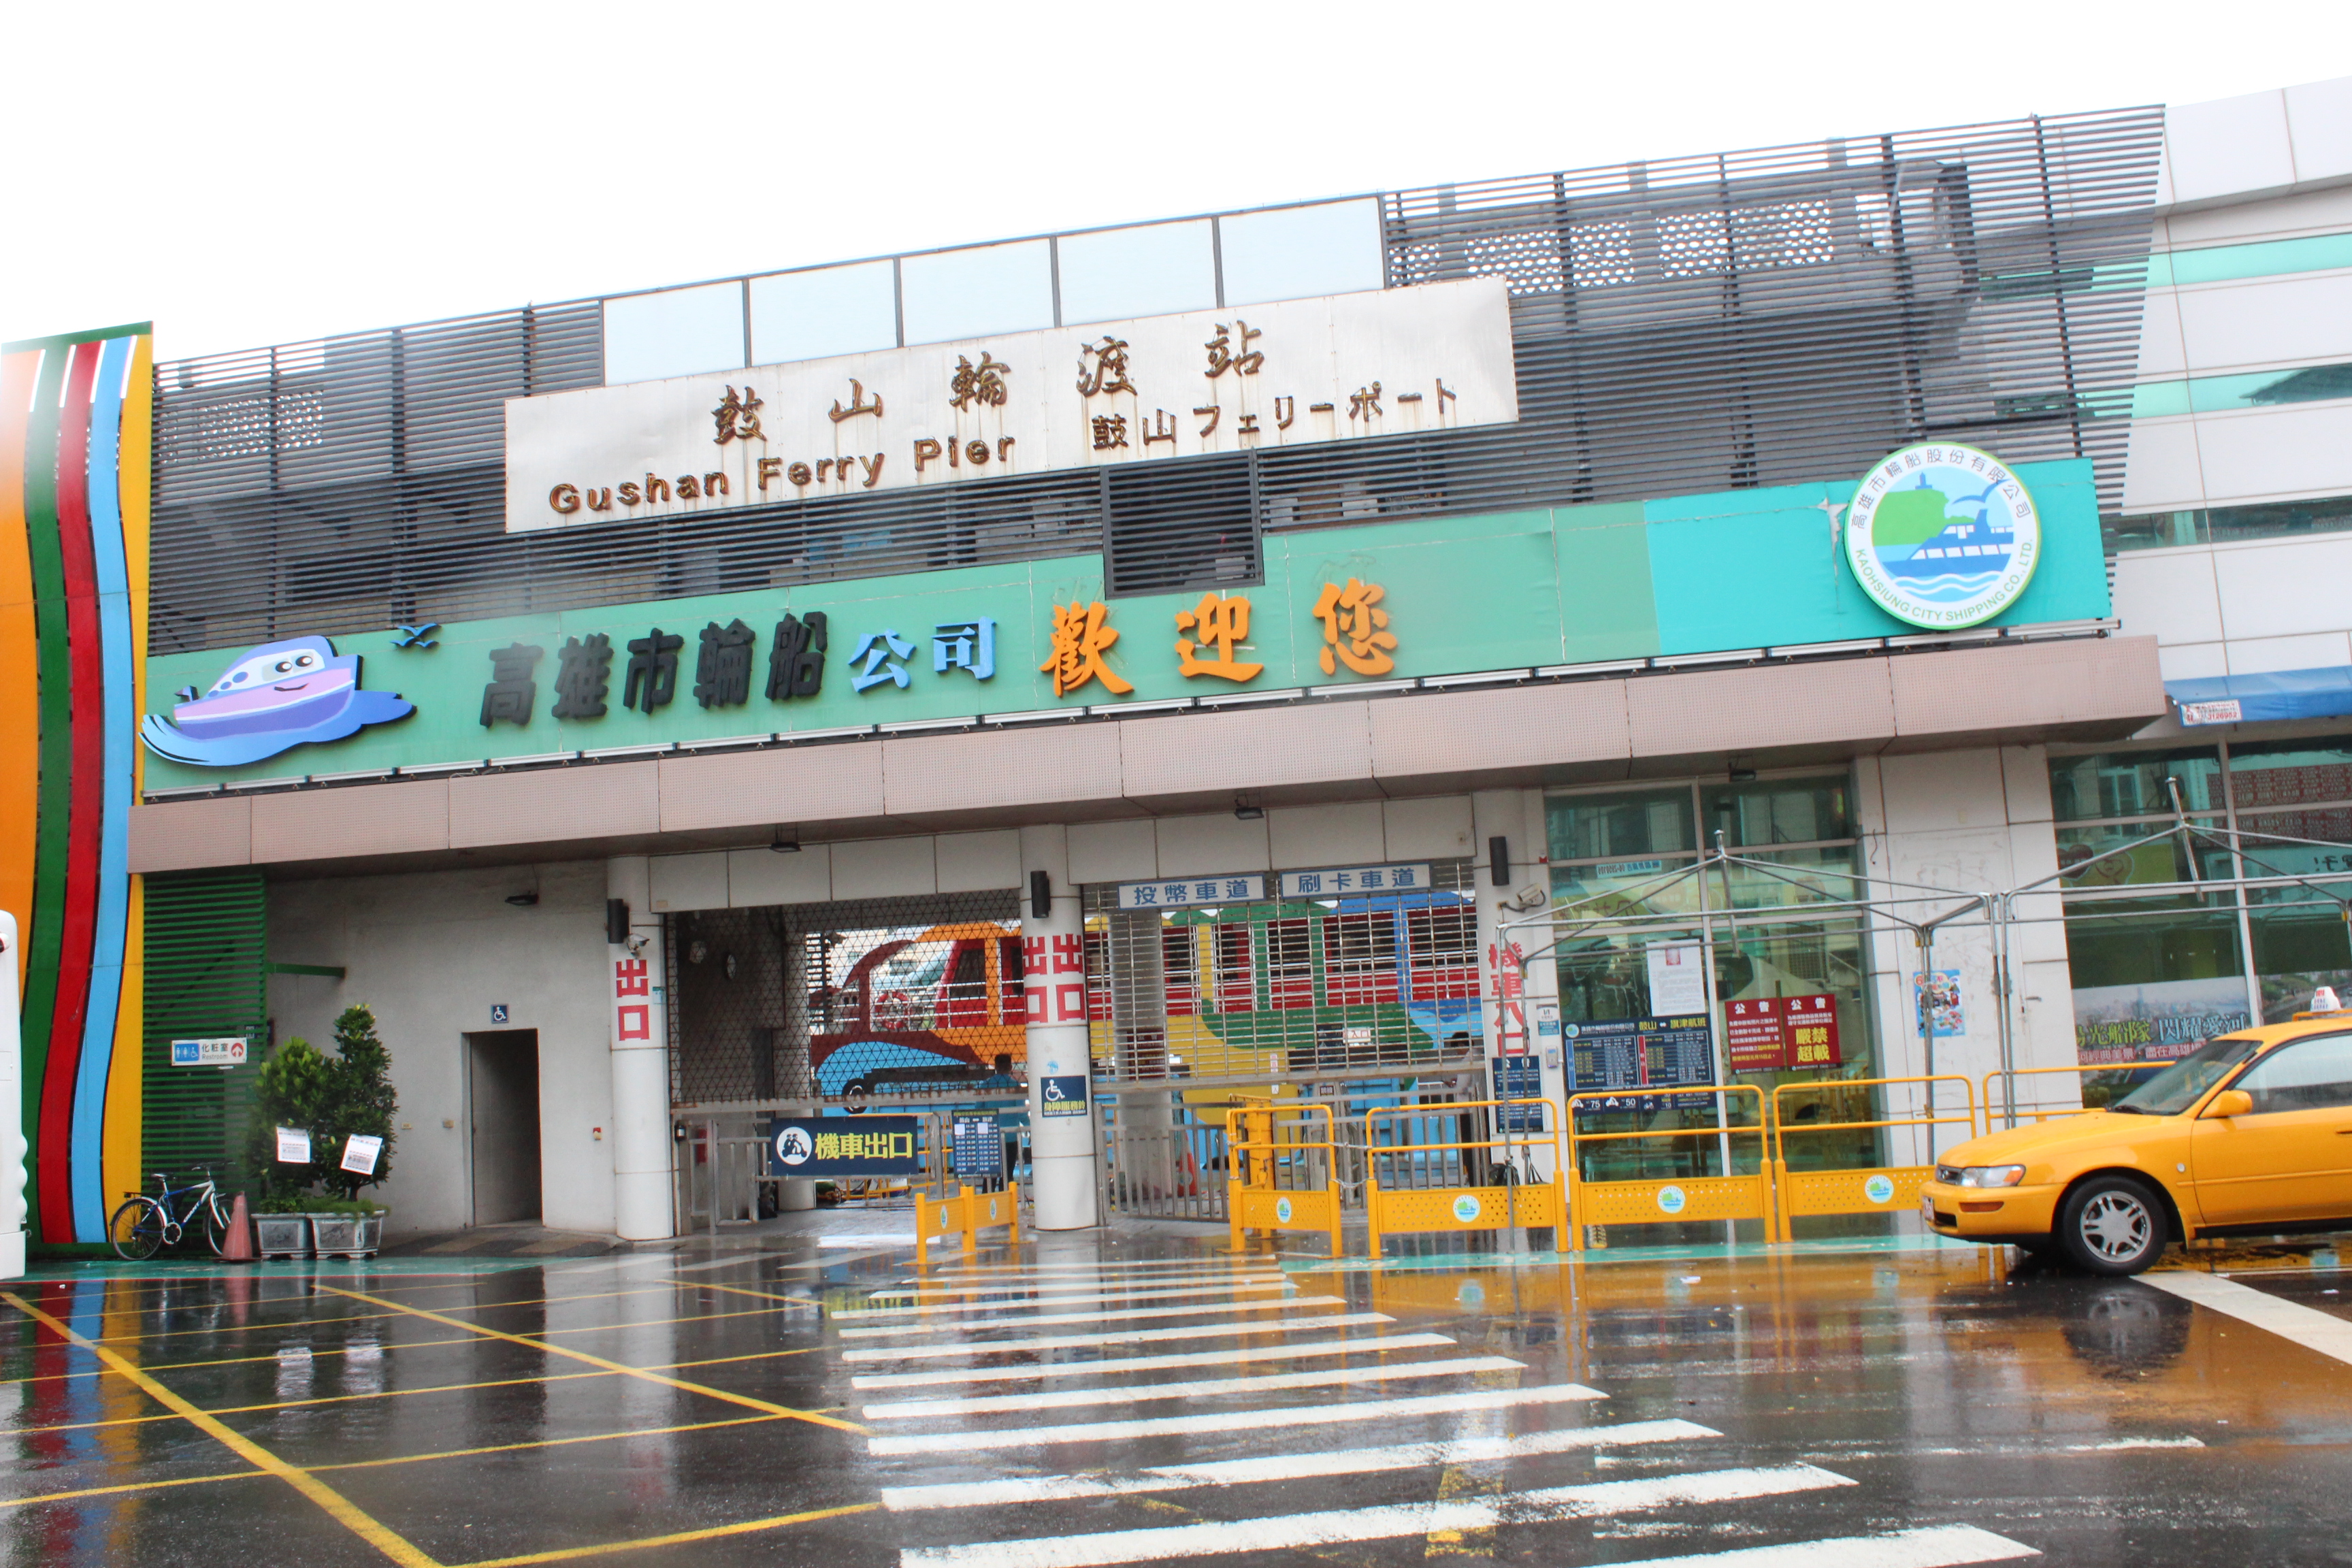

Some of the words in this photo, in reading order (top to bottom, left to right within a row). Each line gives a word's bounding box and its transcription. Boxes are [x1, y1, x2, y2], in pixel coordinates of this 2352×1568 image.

[711, 320, 1264, 444] 鼓山輪渡站
[1092, 378, 1456, 450] 鼓山フェリーポート
[549, 471, 729, 513] Gushan
[757, 451, 885, 490] Ferry
[914, 435, 1015, 471] Pier
[1850, 448, 2031, 529] 高雄市輪船股份有限公司
[1855, 549, 1910, 613] KAOHSIUNG
[1912, 606, 1942, 621] CITY
[1946, 592, 2006, 621] SHIPPING
[2019, 538, 2033, 567] LTD.
[1134, 879, 1250, 906] 投幣車道
[1298, 868, 1416, 894] 刷卡車道
[1022, 936, 1049, 1024] 出口
[1052, 934, 1087, 1022] 出口
[616, 959, 650, 1041] 出口
[1735, 1000, 1769, 1015] 公告
[1791, 997, 1826, 1011] 公告
[1639, 1021, 1657, 1031] 鼓山
[1795, 1027, 1828, 1045] 嚴禁
[2158, 1013, 2246, 1042] 閃耀愛河
[1797, 1044, 1830, 1062] 超載
[1590, 1100, 1601, 1108] 75
[1626, 1098, 1636, 1106] 50
[815, 1132, 913, 1160] 機車出口
